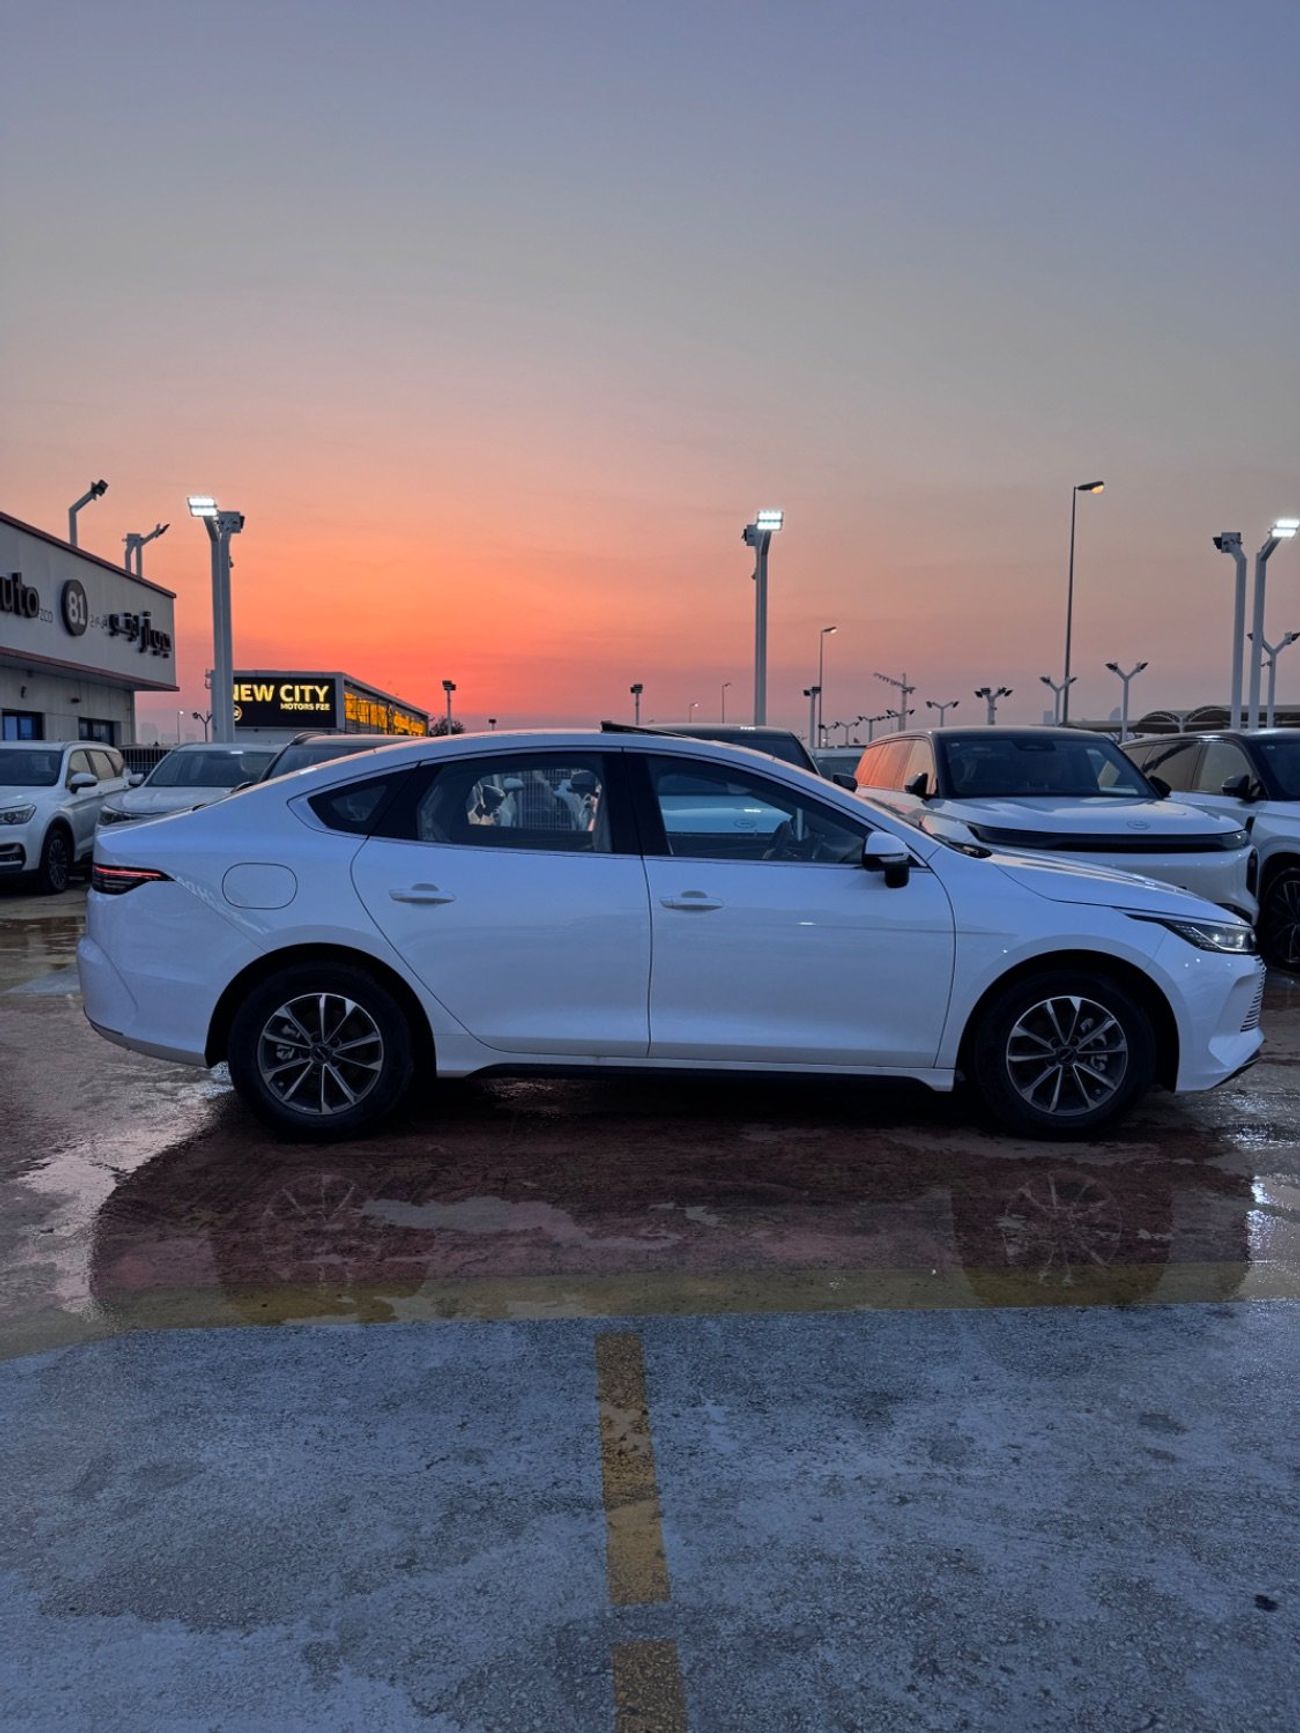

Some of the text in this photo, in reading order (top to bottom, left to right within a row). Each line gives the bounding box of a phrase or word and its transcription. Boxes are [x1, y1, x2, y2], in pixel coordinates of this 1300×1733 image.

[0, 572, 39, 618] uto
[68, 591, 86, 626] 81
[279, 684, 329, 702] CITY
[280, 703, 314, 711] MOTORS
